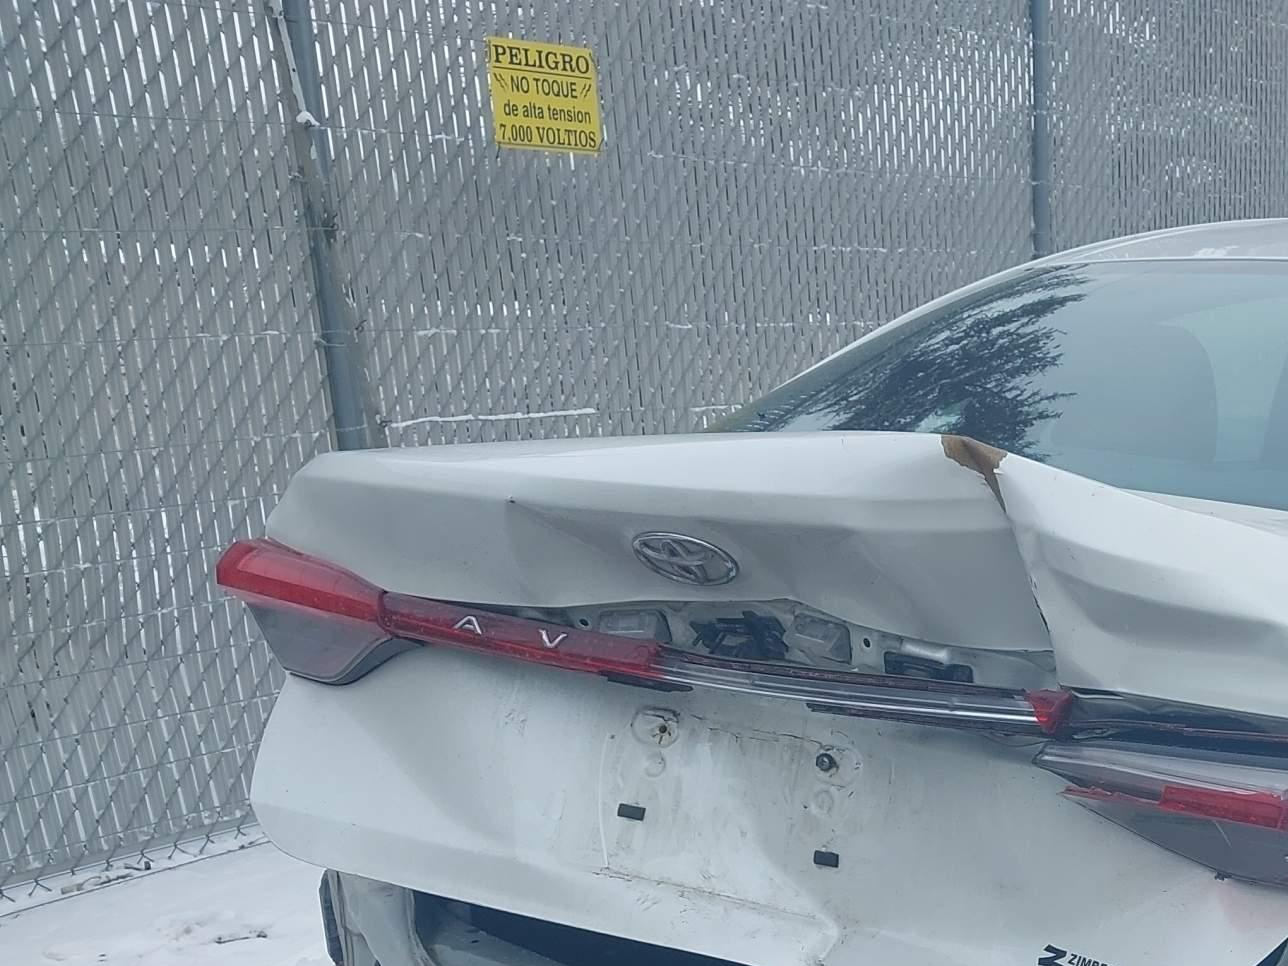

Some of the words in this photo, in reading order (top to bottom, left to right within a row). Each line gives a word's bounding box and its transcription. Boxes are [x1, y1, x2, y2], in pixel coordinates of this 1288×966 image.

[492, 44, 590, 74] PELIGRO
[510, 75, 530, 94] NO
[533, 77, 578, 99] TOQUE
[503, 99, 519, 117] de
[522, 101, 545, 120] alta
[547, 104, 592, 124] tension
[535, 126, 597, 149] VOLTIOS
